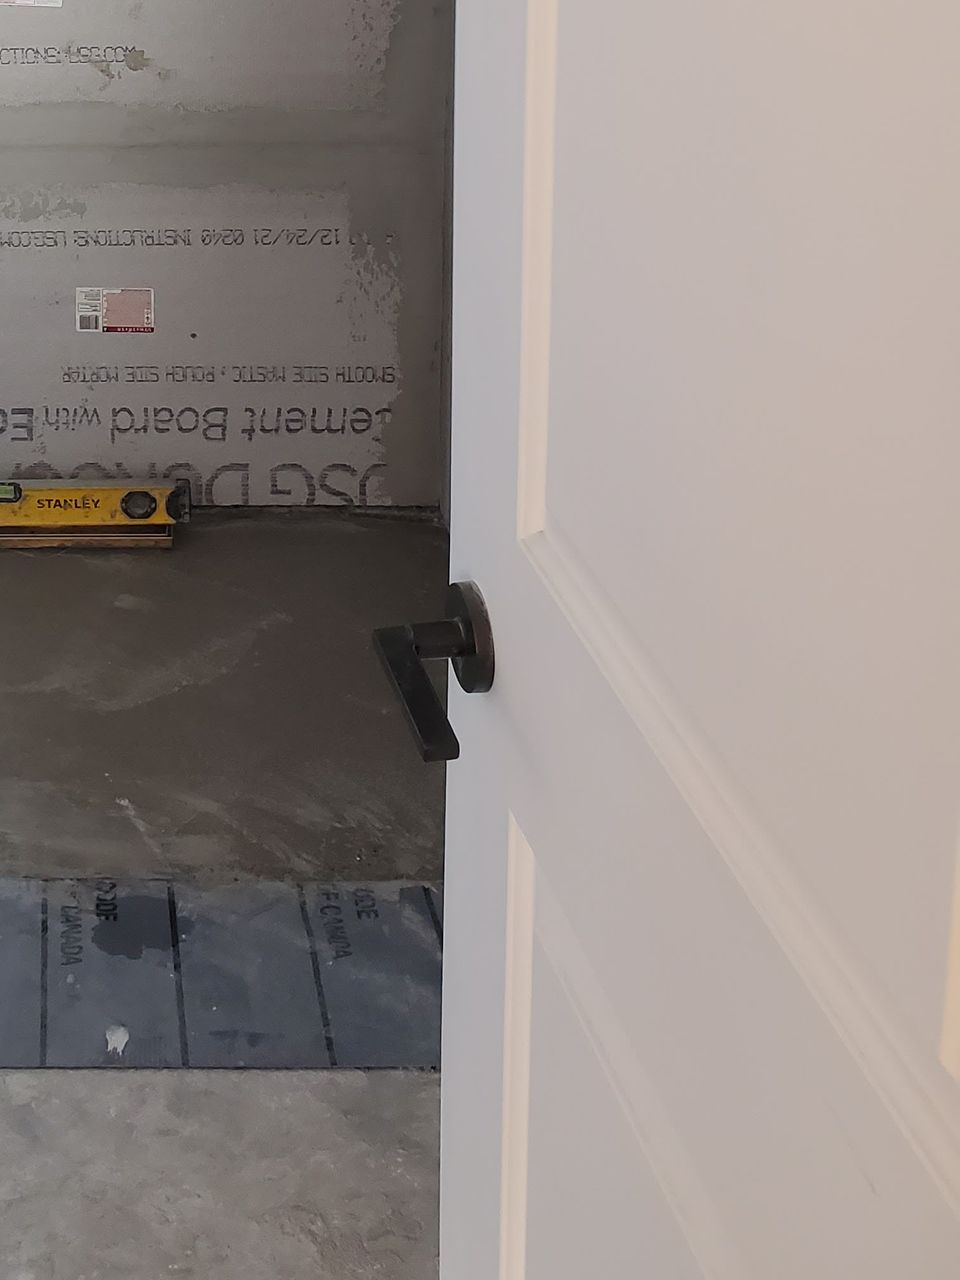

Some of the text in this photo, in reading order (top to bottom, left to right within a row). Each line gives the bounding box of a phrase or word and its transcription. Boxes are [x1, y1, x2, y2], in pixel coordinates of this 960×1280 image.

[254, 228, 341, 247] 12/24/21
[125, 365, 159, 383] SIDE
[233, 366, 287, 384] MASTIC
[292, 366, 329, 384] SIDE
[336, 366, 395, 384] SMOOTH
[42, 403, 101, 431] with
[110, 406, 228, 444] Board
[241, 406, 392, 441] ement
[36, 498, 101, 510] STANLEY
